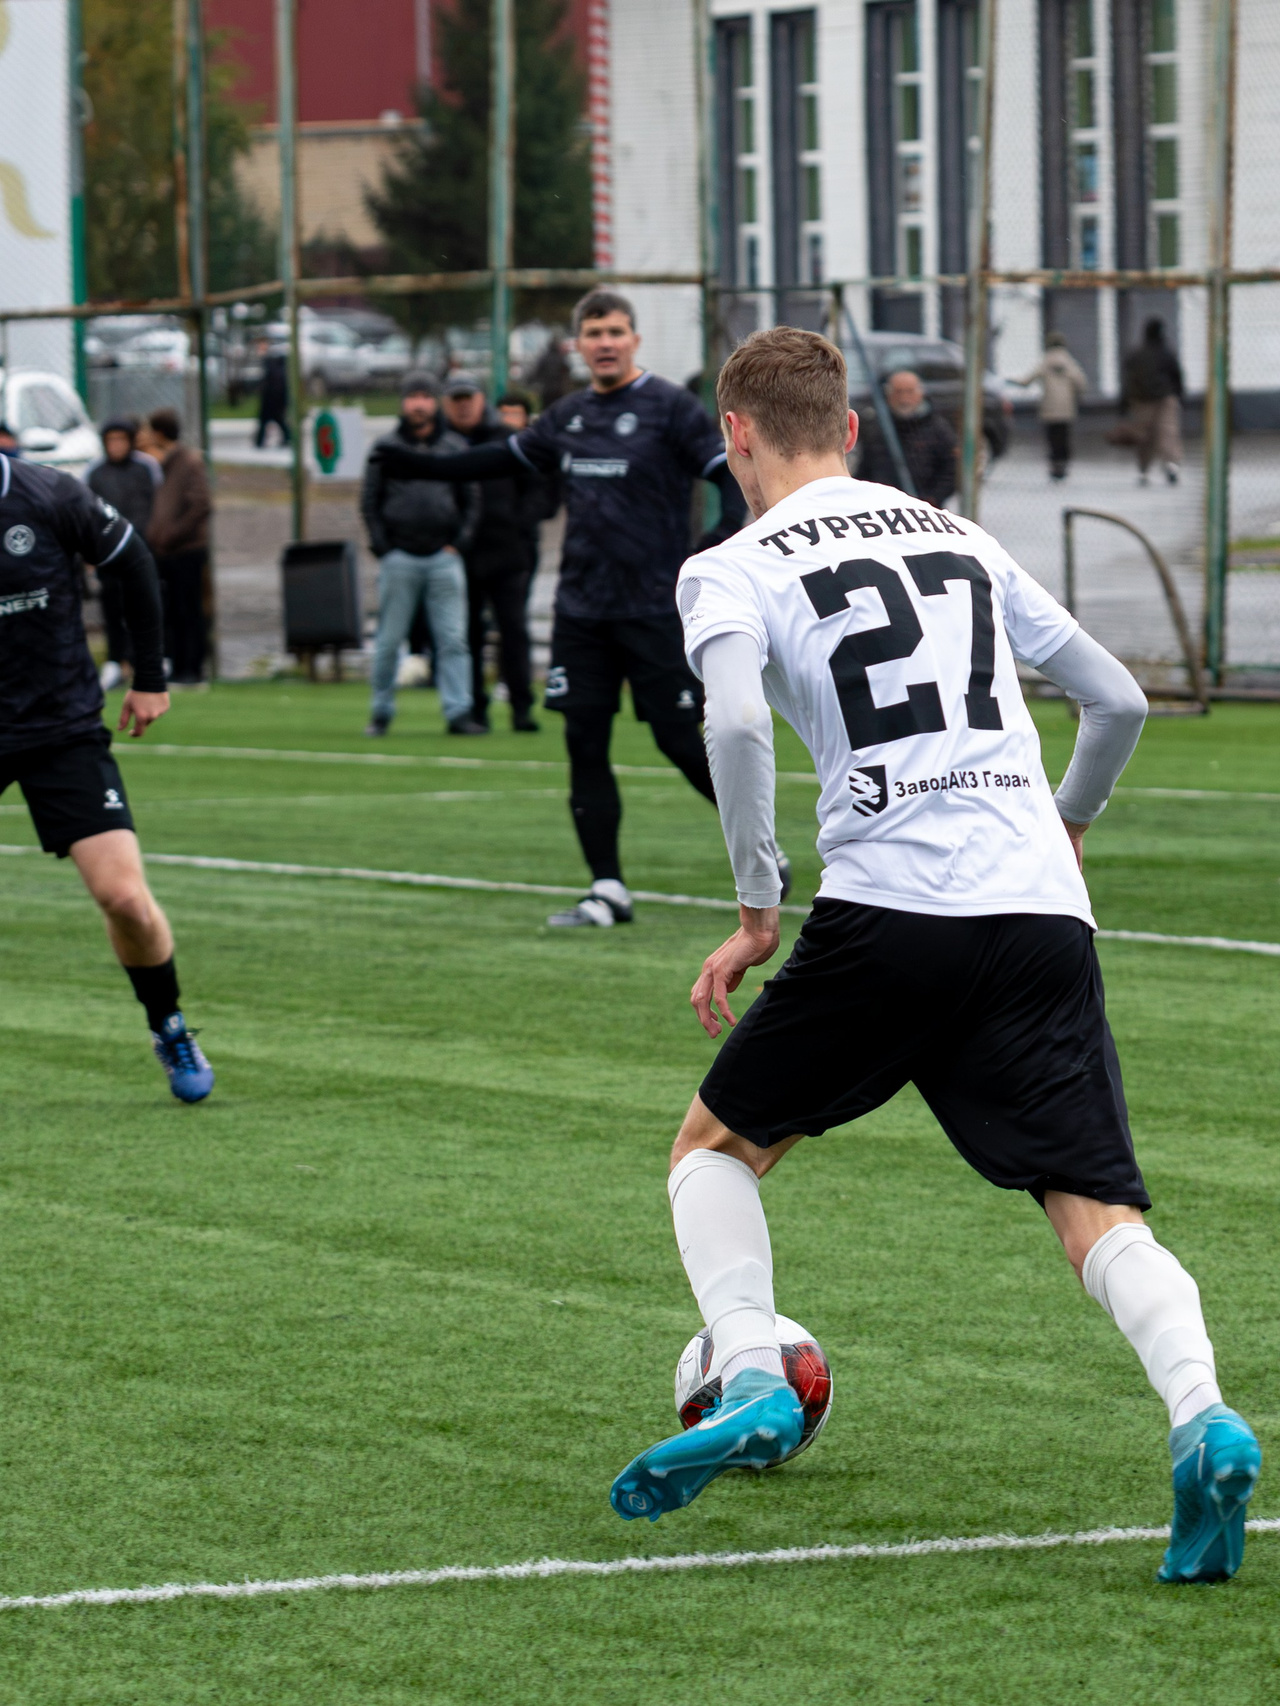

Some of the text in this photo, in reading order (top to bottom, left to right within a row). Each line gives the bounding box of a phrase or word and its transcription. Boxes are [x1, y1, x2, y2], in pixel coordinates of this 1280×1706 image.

[758, 508, 967, 556] ТУРБИНА
[799, 551, 1004, 751] 27
[894, 771, 1031, 798] ЗаводАКЗ Гаран
